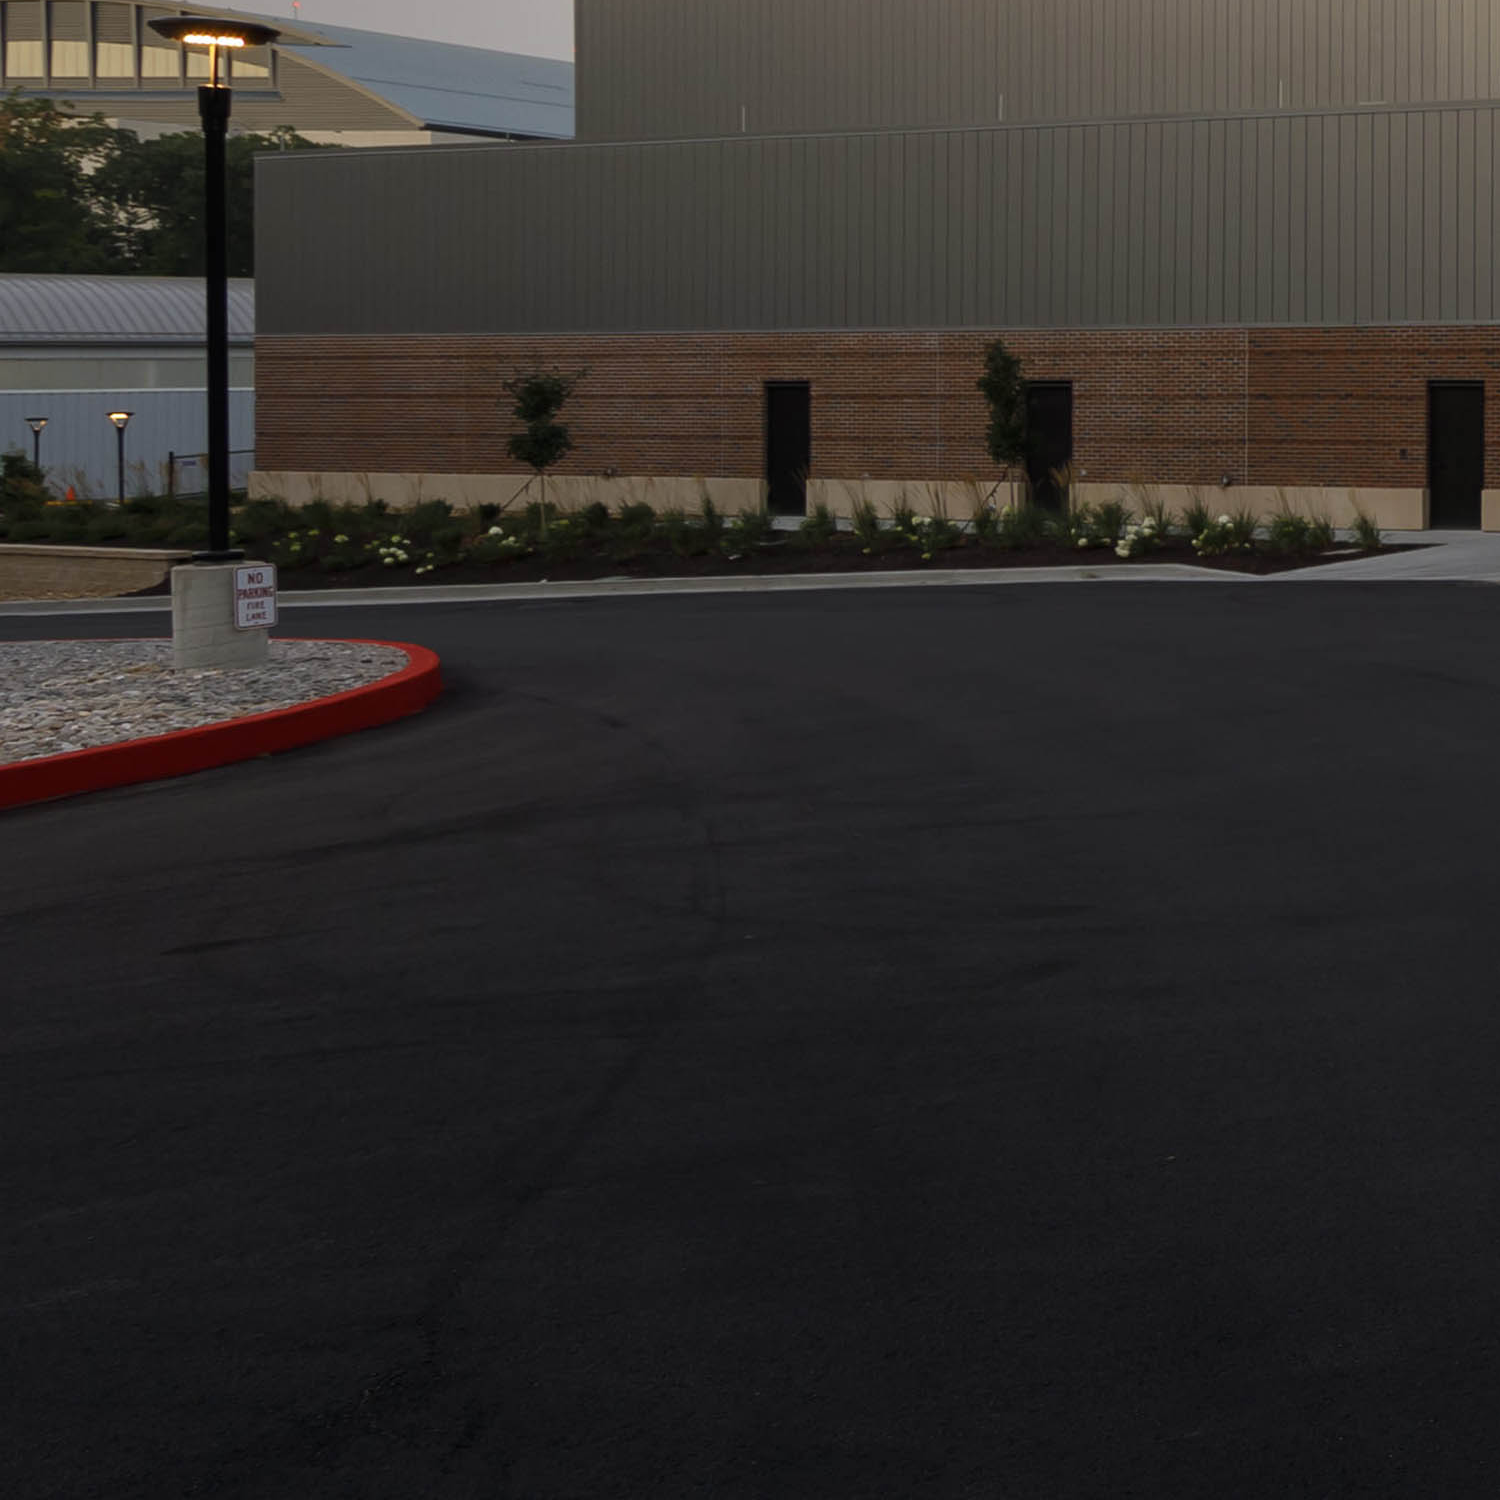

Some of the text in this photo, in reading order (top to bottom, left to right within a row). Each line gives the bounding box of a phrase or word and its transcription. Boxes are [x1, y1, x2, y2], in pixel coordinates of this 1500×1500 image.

[247, 572, 264, 585] NO
[237, 586, 275, 600] PARKING
[246, 601, 265, 610] FIRE
[245, 611, 267, 622] LANE
